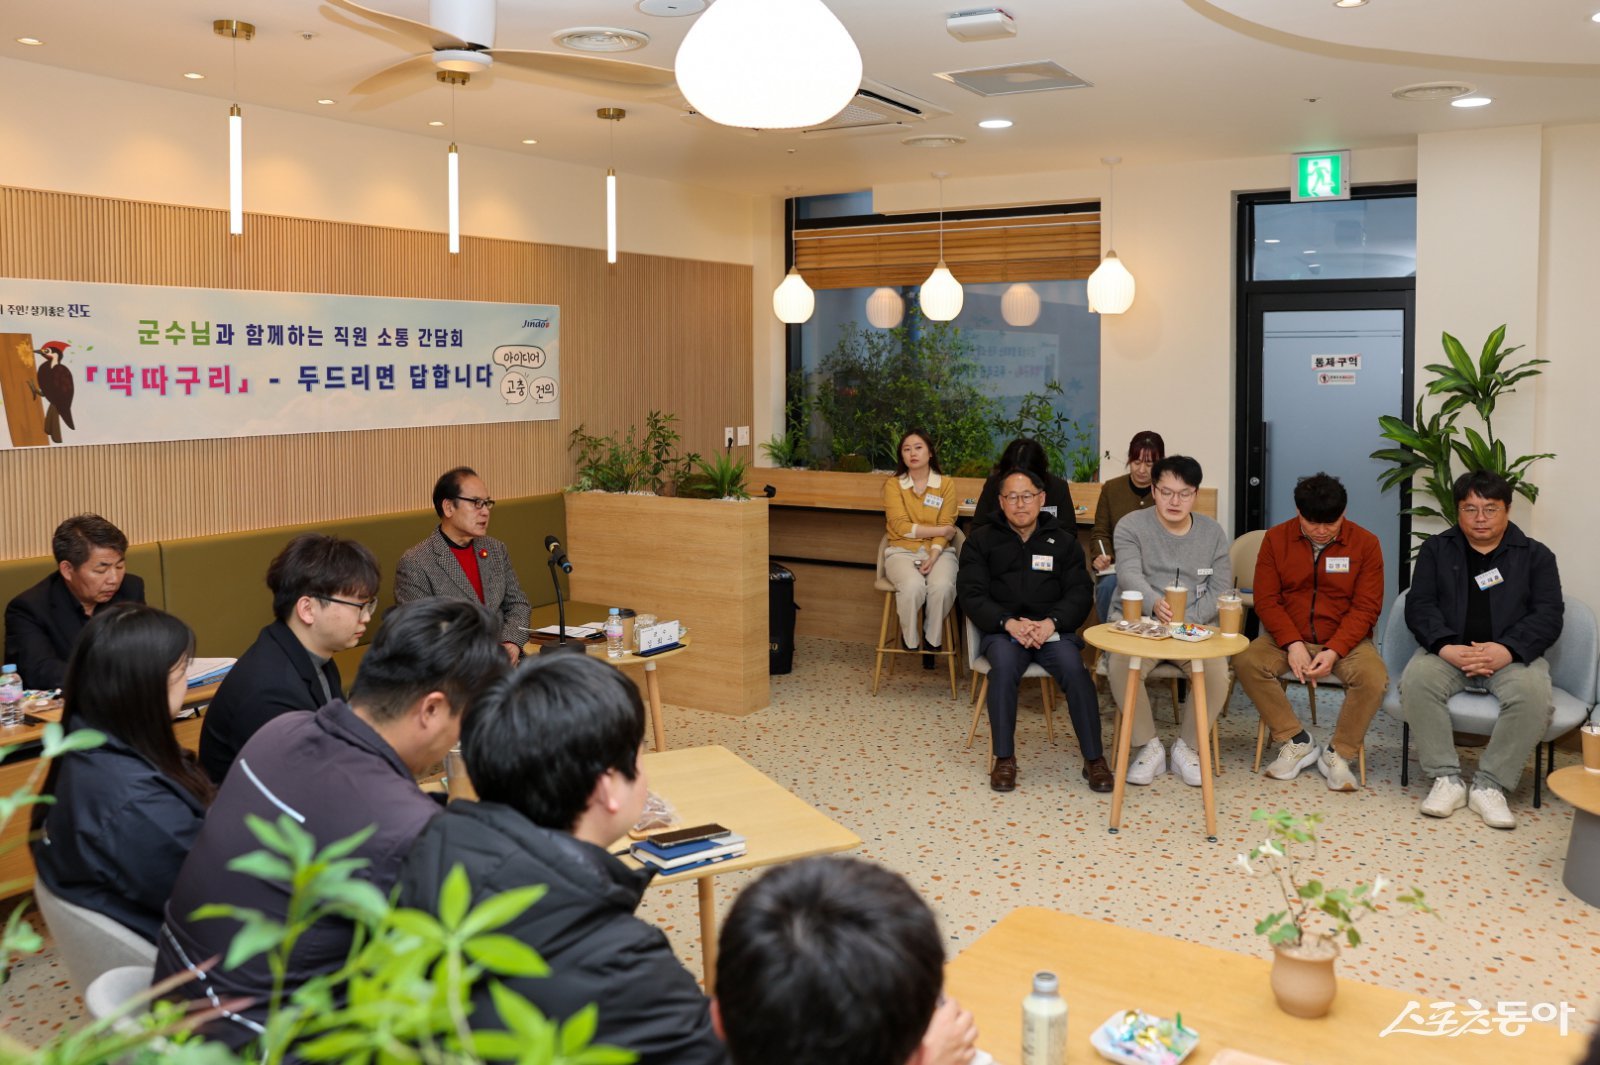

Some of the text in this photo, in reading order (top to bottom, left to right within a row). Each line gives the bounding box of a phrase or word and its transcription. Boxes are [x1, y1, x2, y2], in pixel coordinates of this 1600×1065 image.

[7, 304, 29, 316] 주인!
[31, 305, 65, 317] 살기좋은
[67, 303, 91, 318] 진도
[137, 319, 463, 348] 군수님과 함께하는 직원 소통 간담회
[503, 351, 540, 366] 아이디어
[297, 364, 396, 392] 두드리면
[409, 364, 494, 389] 답합니다
[506, 378, 526, 397] 고충
[535, 382, 555, 399] 건의
